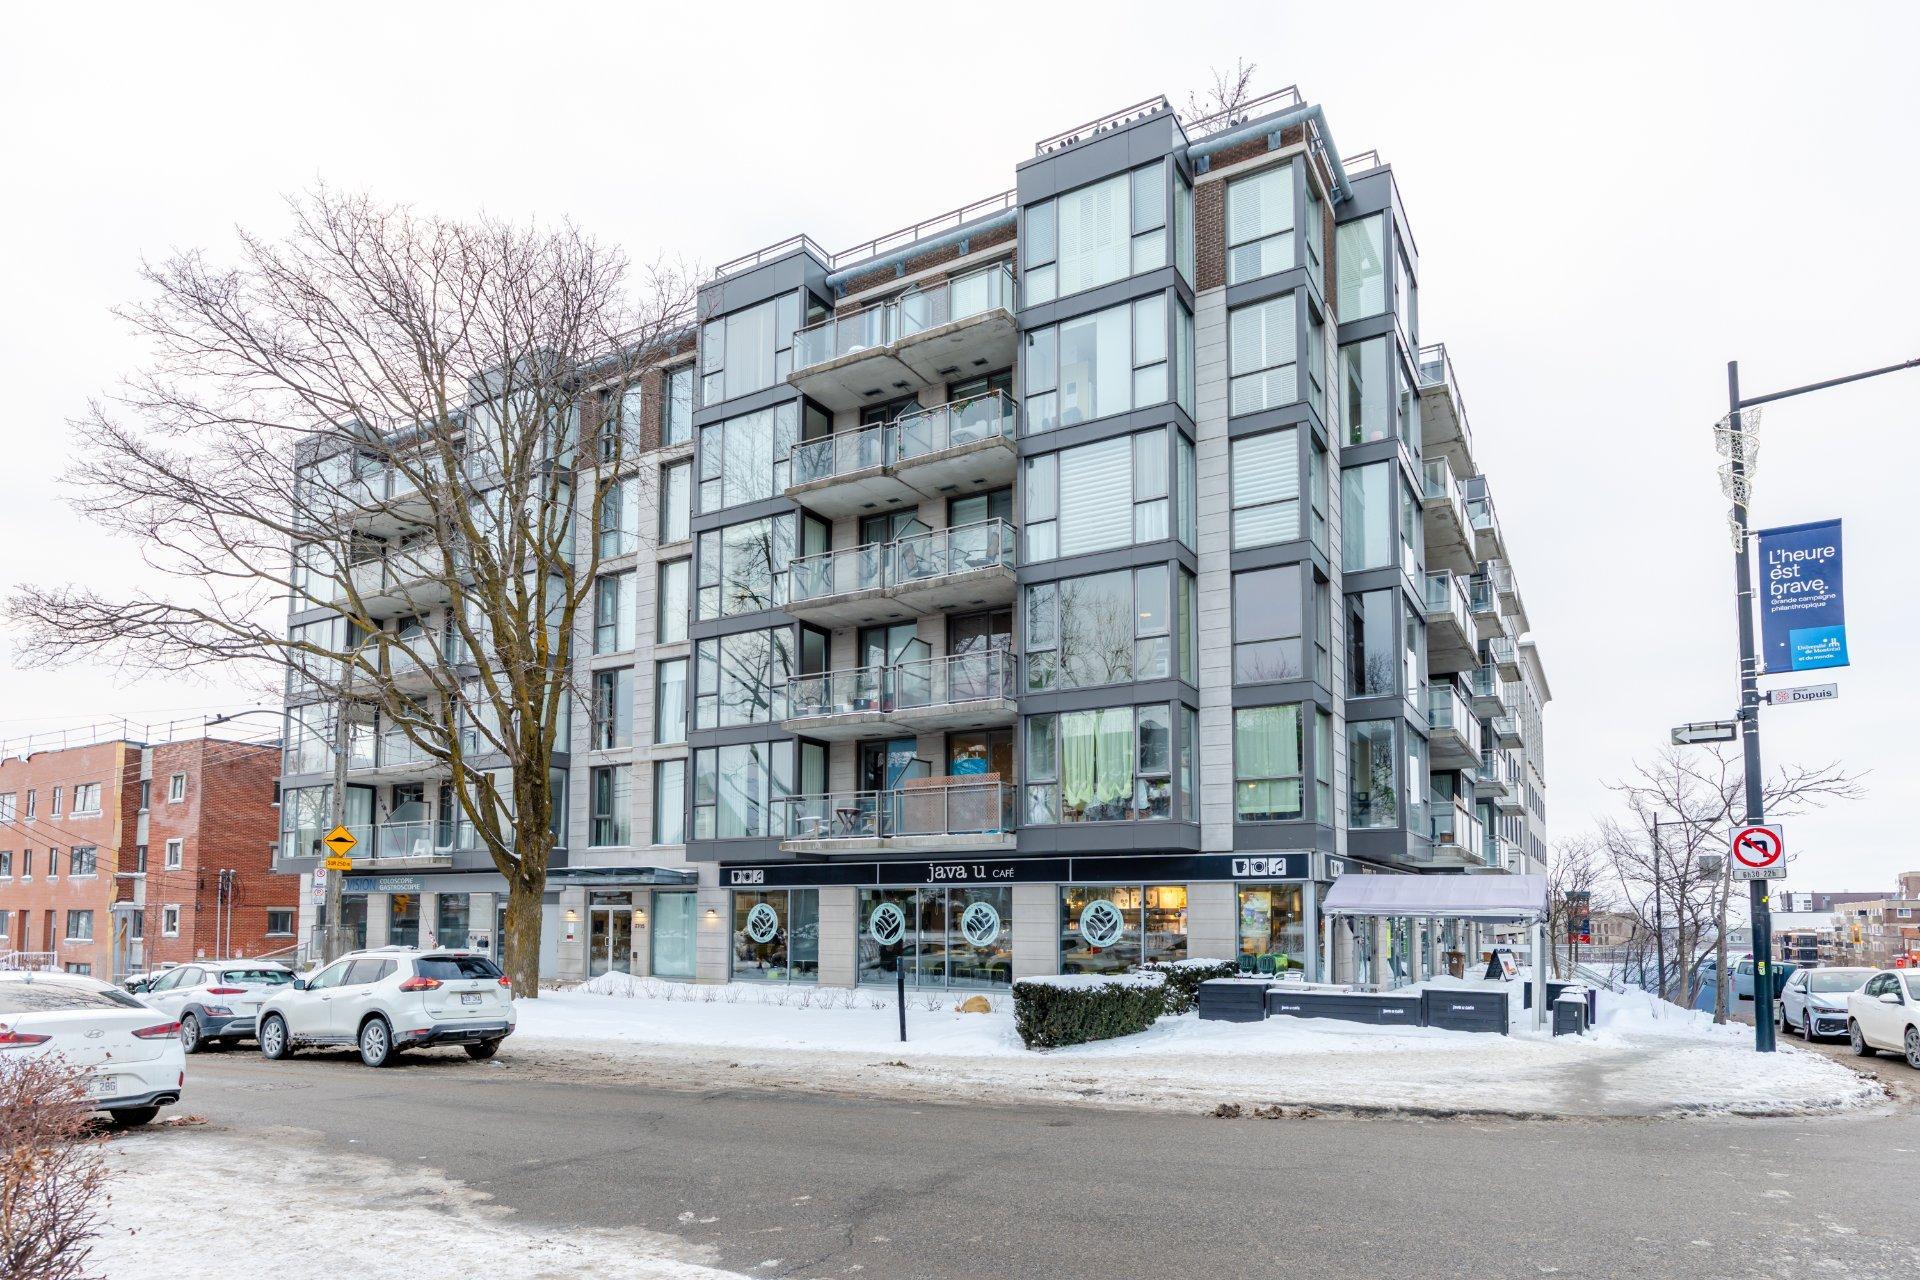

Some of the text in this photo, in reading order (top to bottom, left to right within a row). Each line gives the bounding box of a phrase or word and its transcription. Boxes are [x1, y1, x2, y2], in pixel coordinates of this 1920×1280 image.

[1770, 564, 1801, 580] est
[1770, 579, 1829, 596] brave.
[1771, 593, 1837, 605] Grande campagne
[1771, 601, 1826, 613] philanthropique
[1793, 689, 1832, 701] Dupuis
[926, 863, 1015, 883] java u CAFÉ
[379, 883, 421, 891] GASTROSCOPIE
